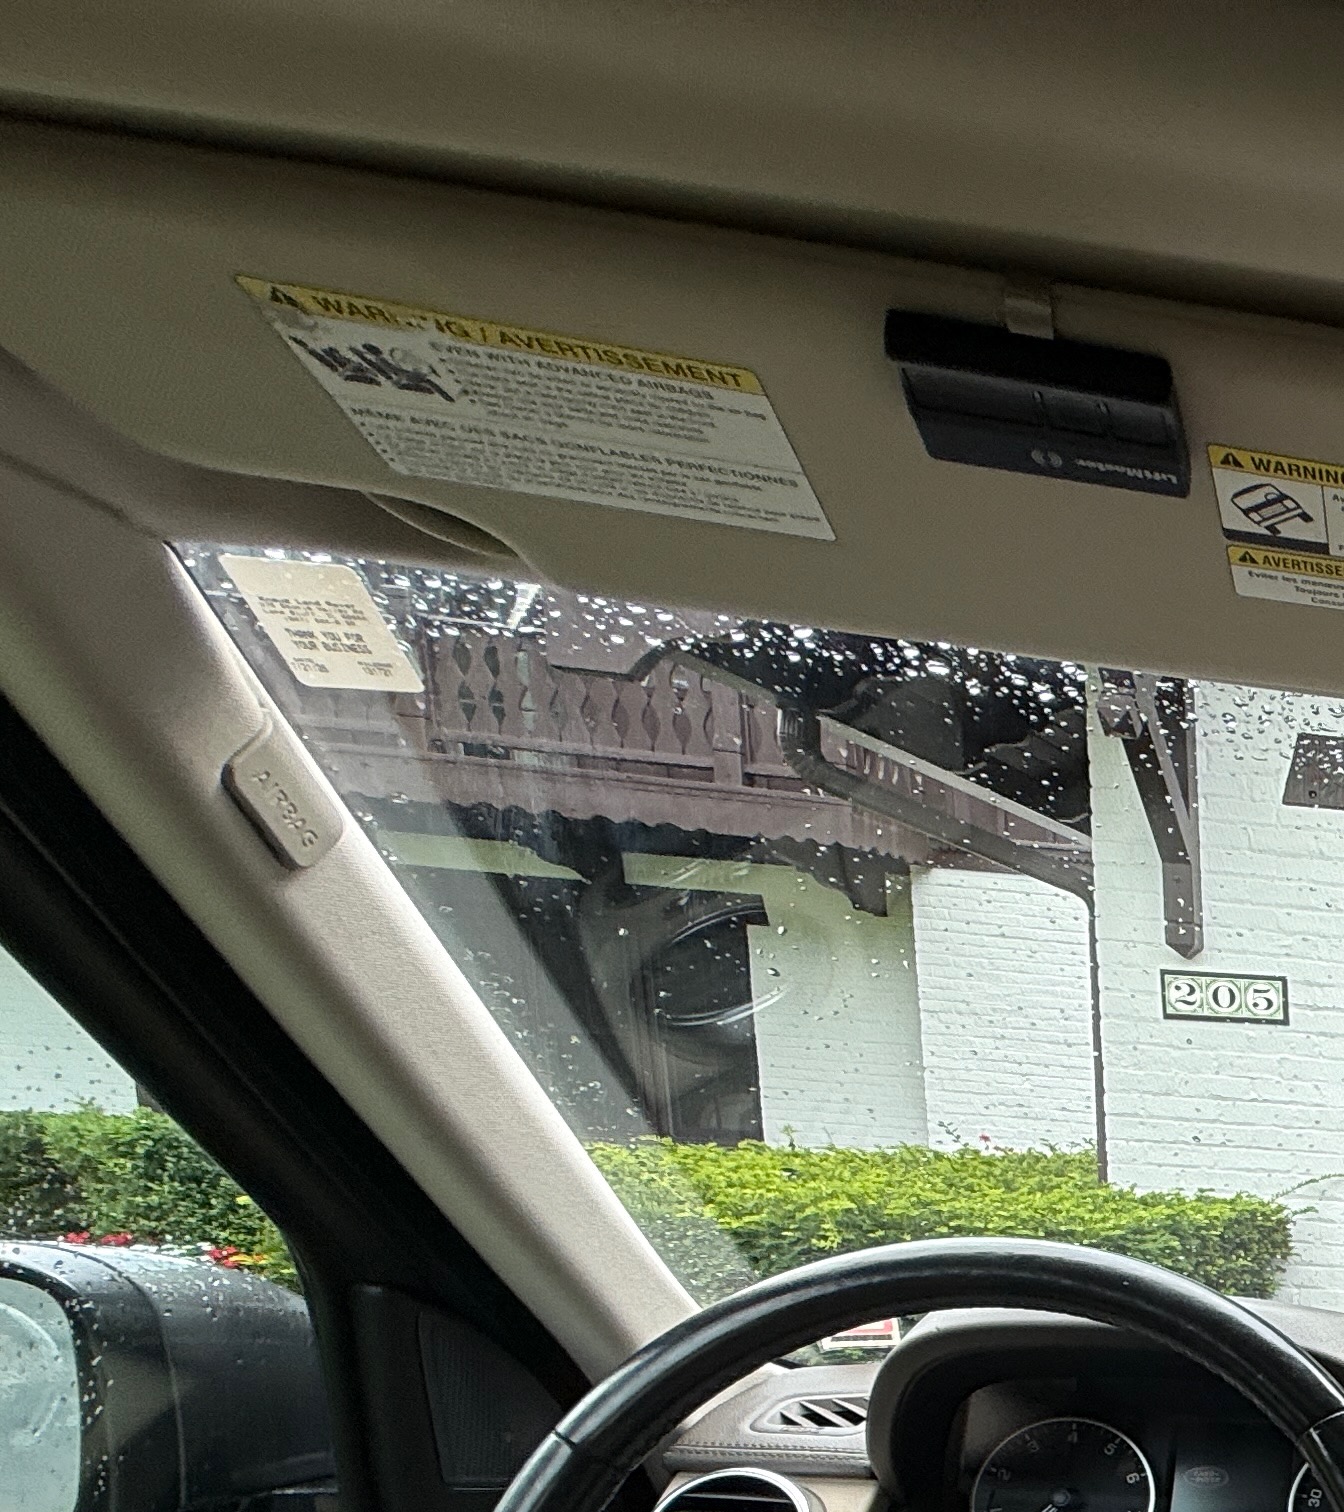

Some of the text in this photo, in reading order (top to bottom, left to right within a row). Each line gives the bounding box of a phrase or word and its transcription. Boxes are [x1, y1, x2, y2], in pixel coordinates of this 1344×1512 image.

[498, 332, 744, 388] AVERTISSEMENT
[1294, 585, 1340, 598] Toujours
[252, 769, 319, 848] AIRBAG
[1174, 982, 1274, 1011] 205
[1027, 1441, 1041, 1453] 3
[1104, 1442, 1118, 1456] 5
[997, 1469, 1011, 1481] 2
[1125, 1473, 1140, 1484] 6
[1308, 1488, 1322, 1508] 30
